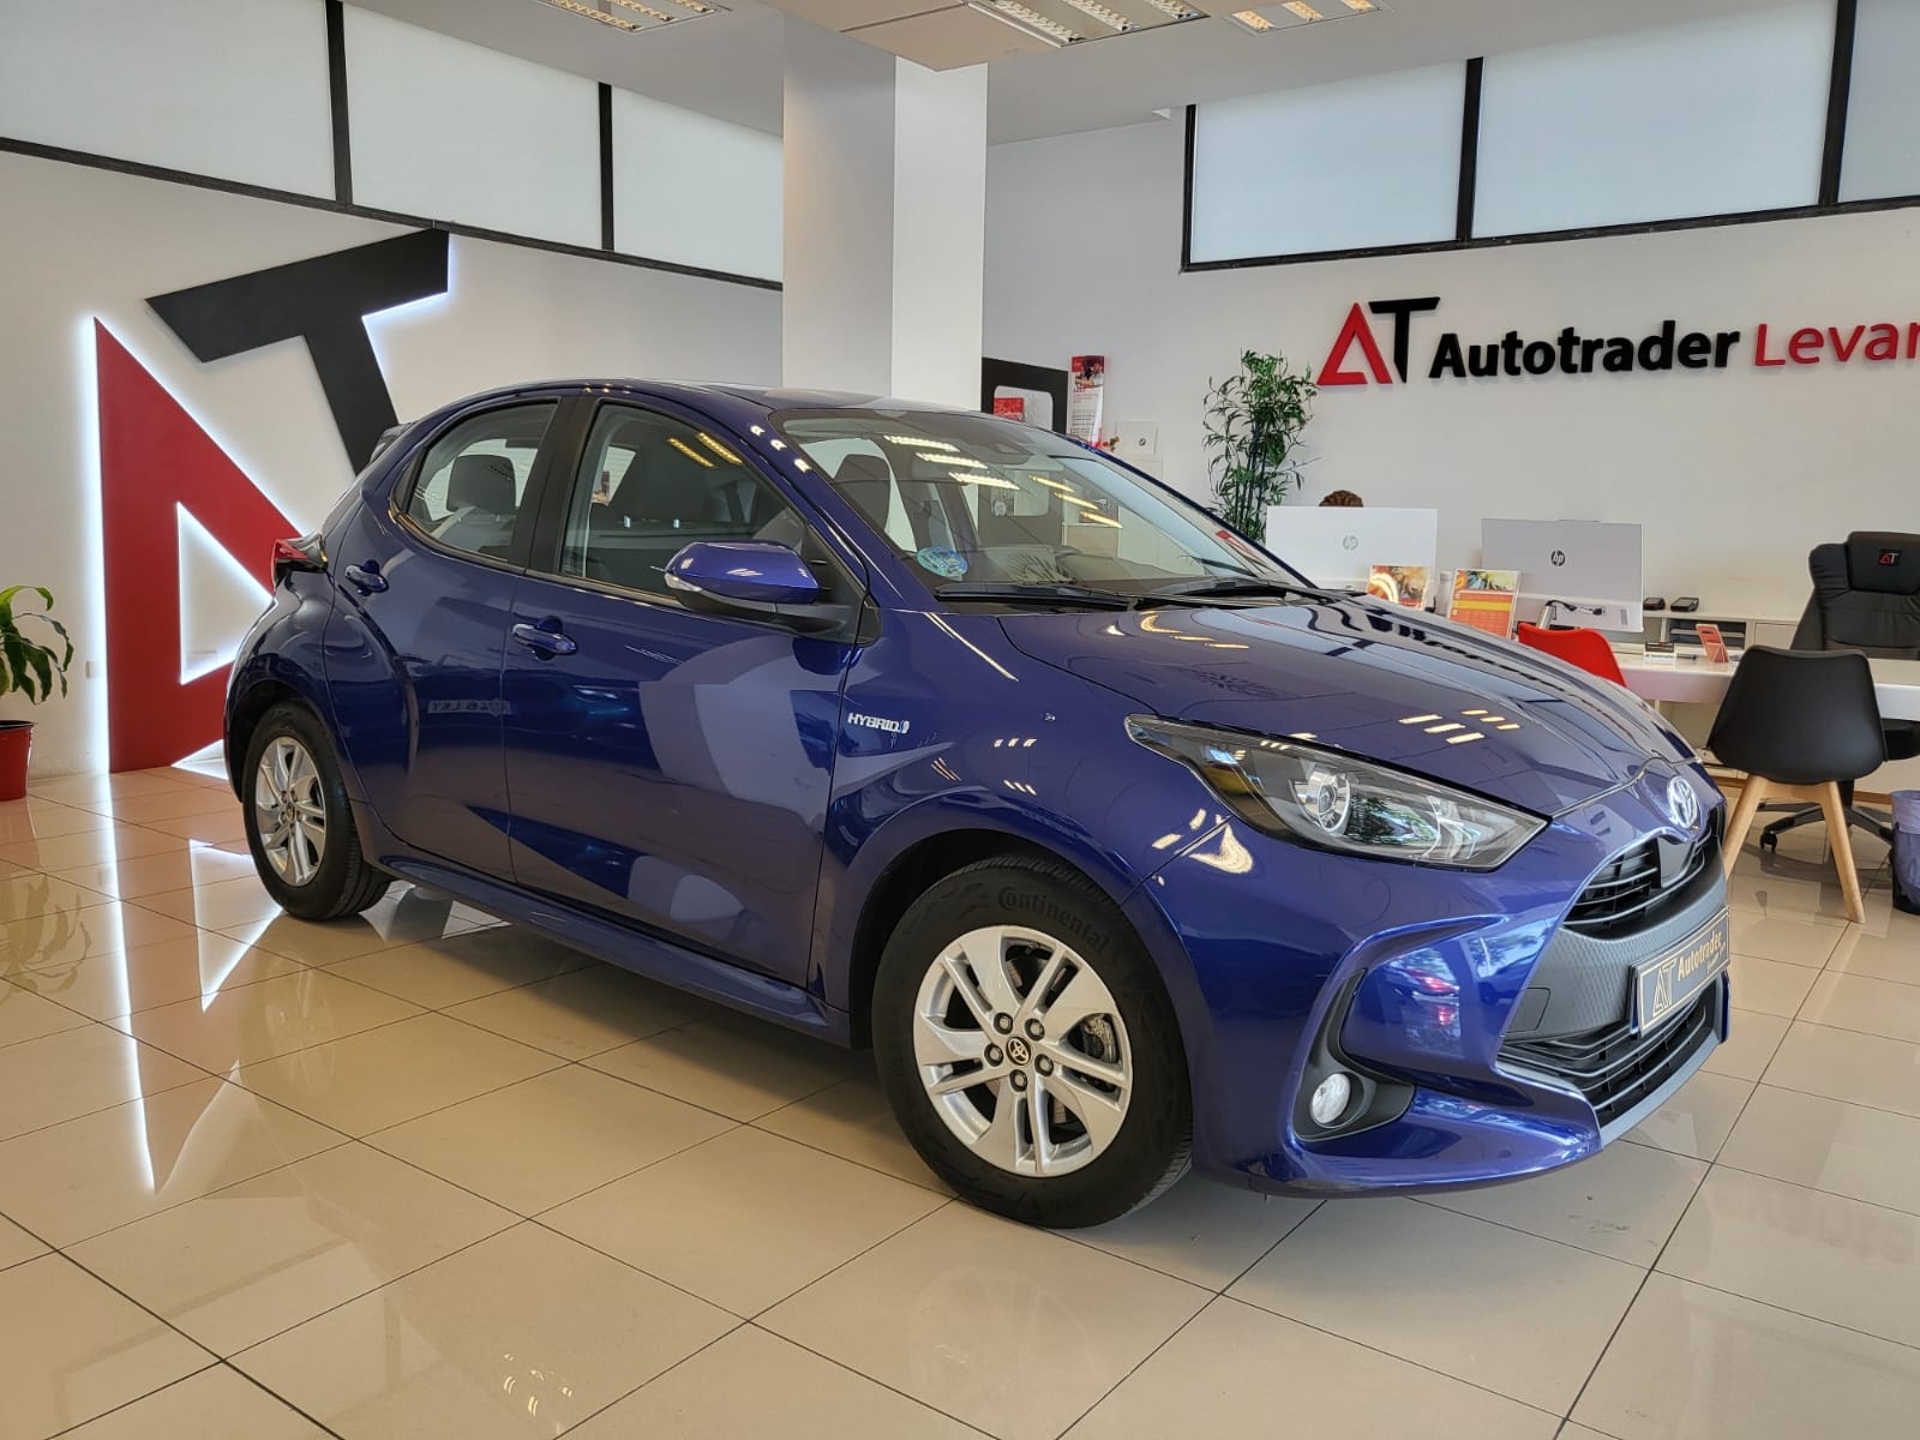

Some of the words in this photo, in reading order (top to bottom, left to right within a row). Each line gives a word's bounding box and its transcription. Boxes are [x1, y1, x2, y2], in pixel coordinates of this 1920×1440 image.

[1316, 297, 1440, 385] AT
[1429, 320, 1740, 379] Autotrader
[848, 712, 900, 732] HYBRID
[998, 886, 1111, 953] Continental
